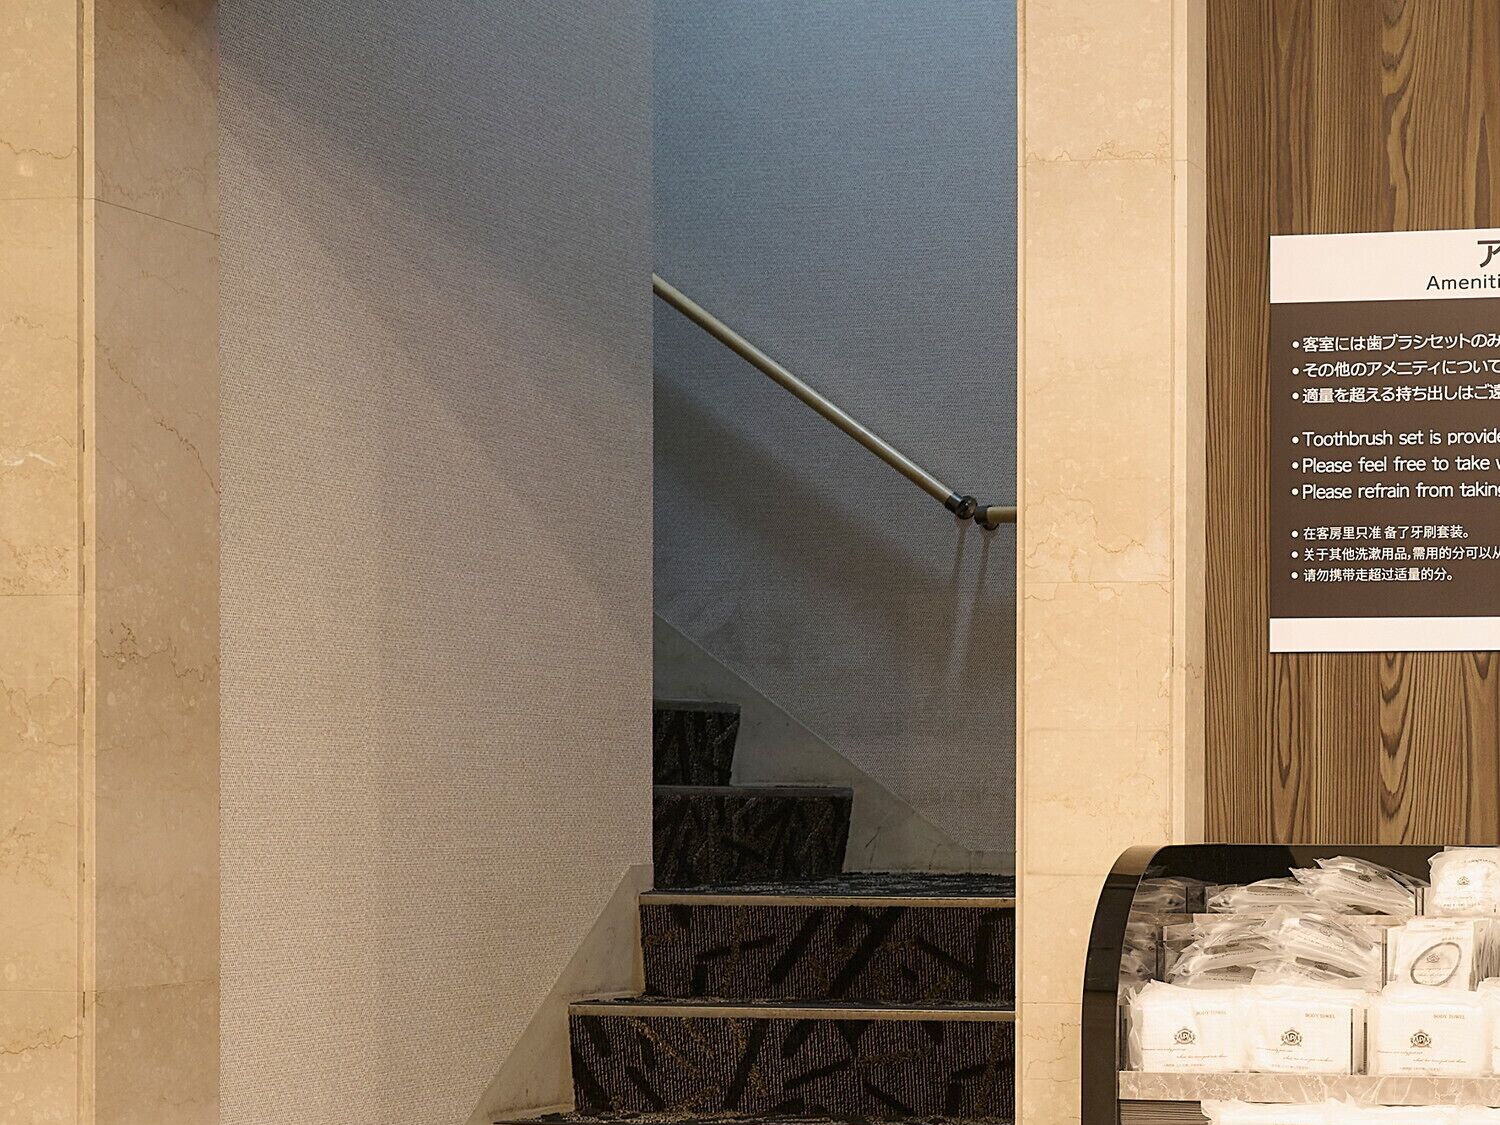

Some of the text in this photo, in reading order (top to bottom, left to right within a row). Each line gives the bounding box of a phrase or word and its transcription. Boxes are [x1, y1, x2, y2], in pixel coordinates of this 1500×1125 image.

[1302, 430, 1393, 447] Toothbrush
[1399, 430, 1424, 445] set
[1430, 429, 1441, 444] is
[1302, 457, 1352, 473] Please
[1357, 456, 1387, 472] feel
[1393, 455, 1426, 471] free
[1432, 456, 1449, 471] to
[1455, 455, 1490, 470] take
[1302, 484, 1352, 499] Please
[1357, 483, 1410, 499] refrain
[1416, 482, 1453, 498] from
[1303, 525, 1469, 541] 在客房里只准备了牙刷套装。
[1303, 567, 1453, 582] 请勿携带走超过适量的分。
